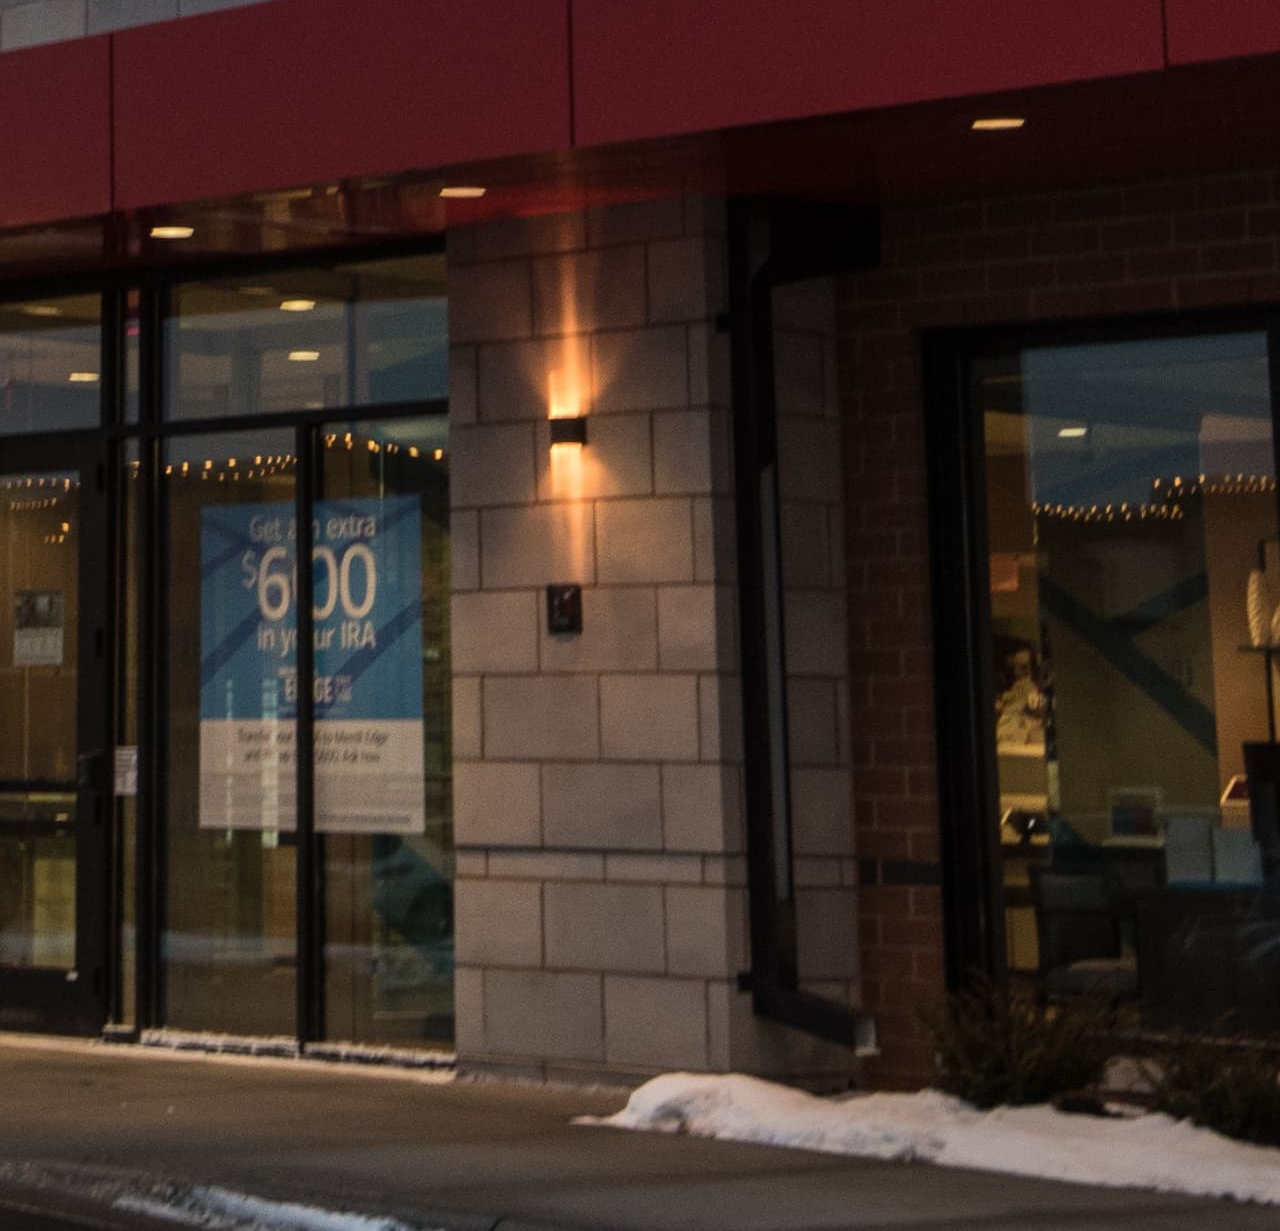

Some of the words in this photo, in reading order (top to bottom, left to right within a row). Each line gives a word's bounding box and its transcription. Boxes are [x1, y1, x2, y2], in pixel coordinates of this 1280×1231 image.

[250, 515, 281, 540] Get
[326, 515, 376, 540] extra
[258, 623, 276, 650] in
[280, 627, 336, 659] yur
[341, 620, 377, 650] IRA
